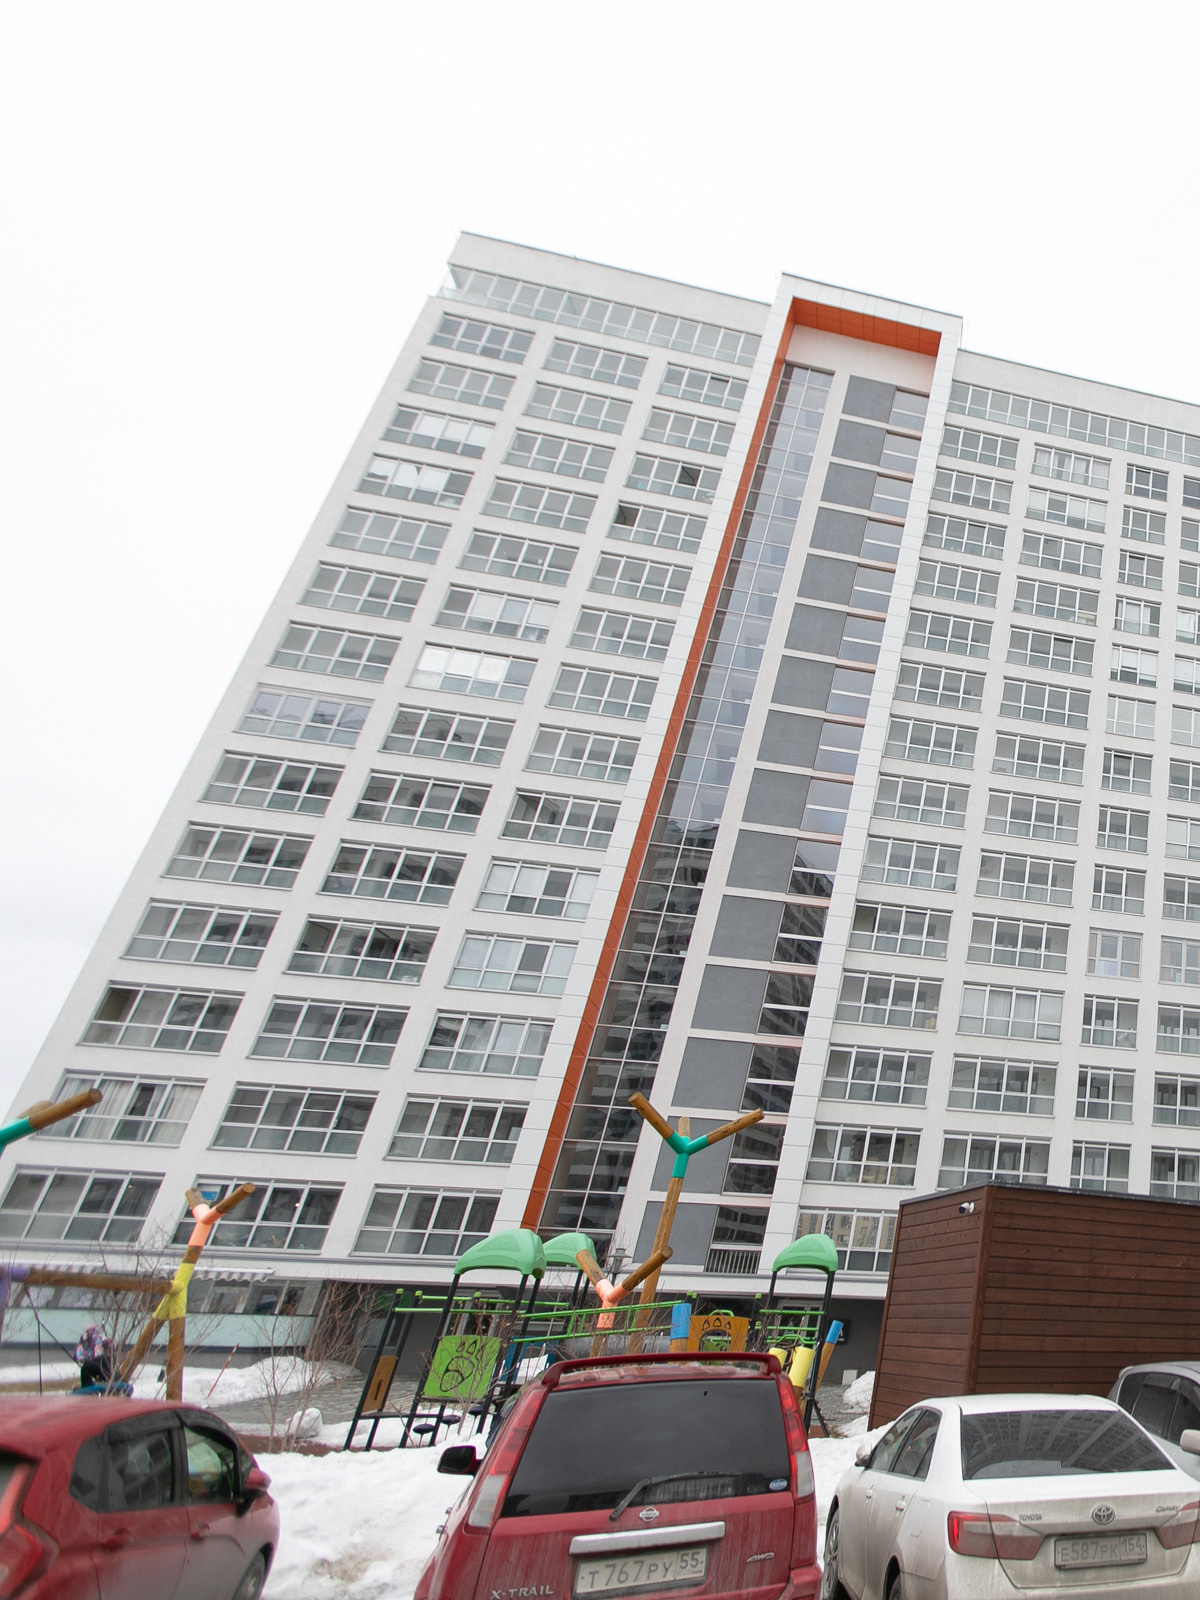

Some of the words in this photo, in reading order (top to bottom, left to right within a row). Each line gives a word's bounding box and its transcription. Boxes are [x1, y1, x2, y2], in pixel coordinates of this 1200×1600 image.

[1121, 1537, 1143, 1553] 154
[746, 1552, 775, 1562] AWD
[588, 1560, 673, 1588] Т767РУ
[679, 1551, 701, 1570] 55
[490, 1584, 554, 1600] X-TRAIL
